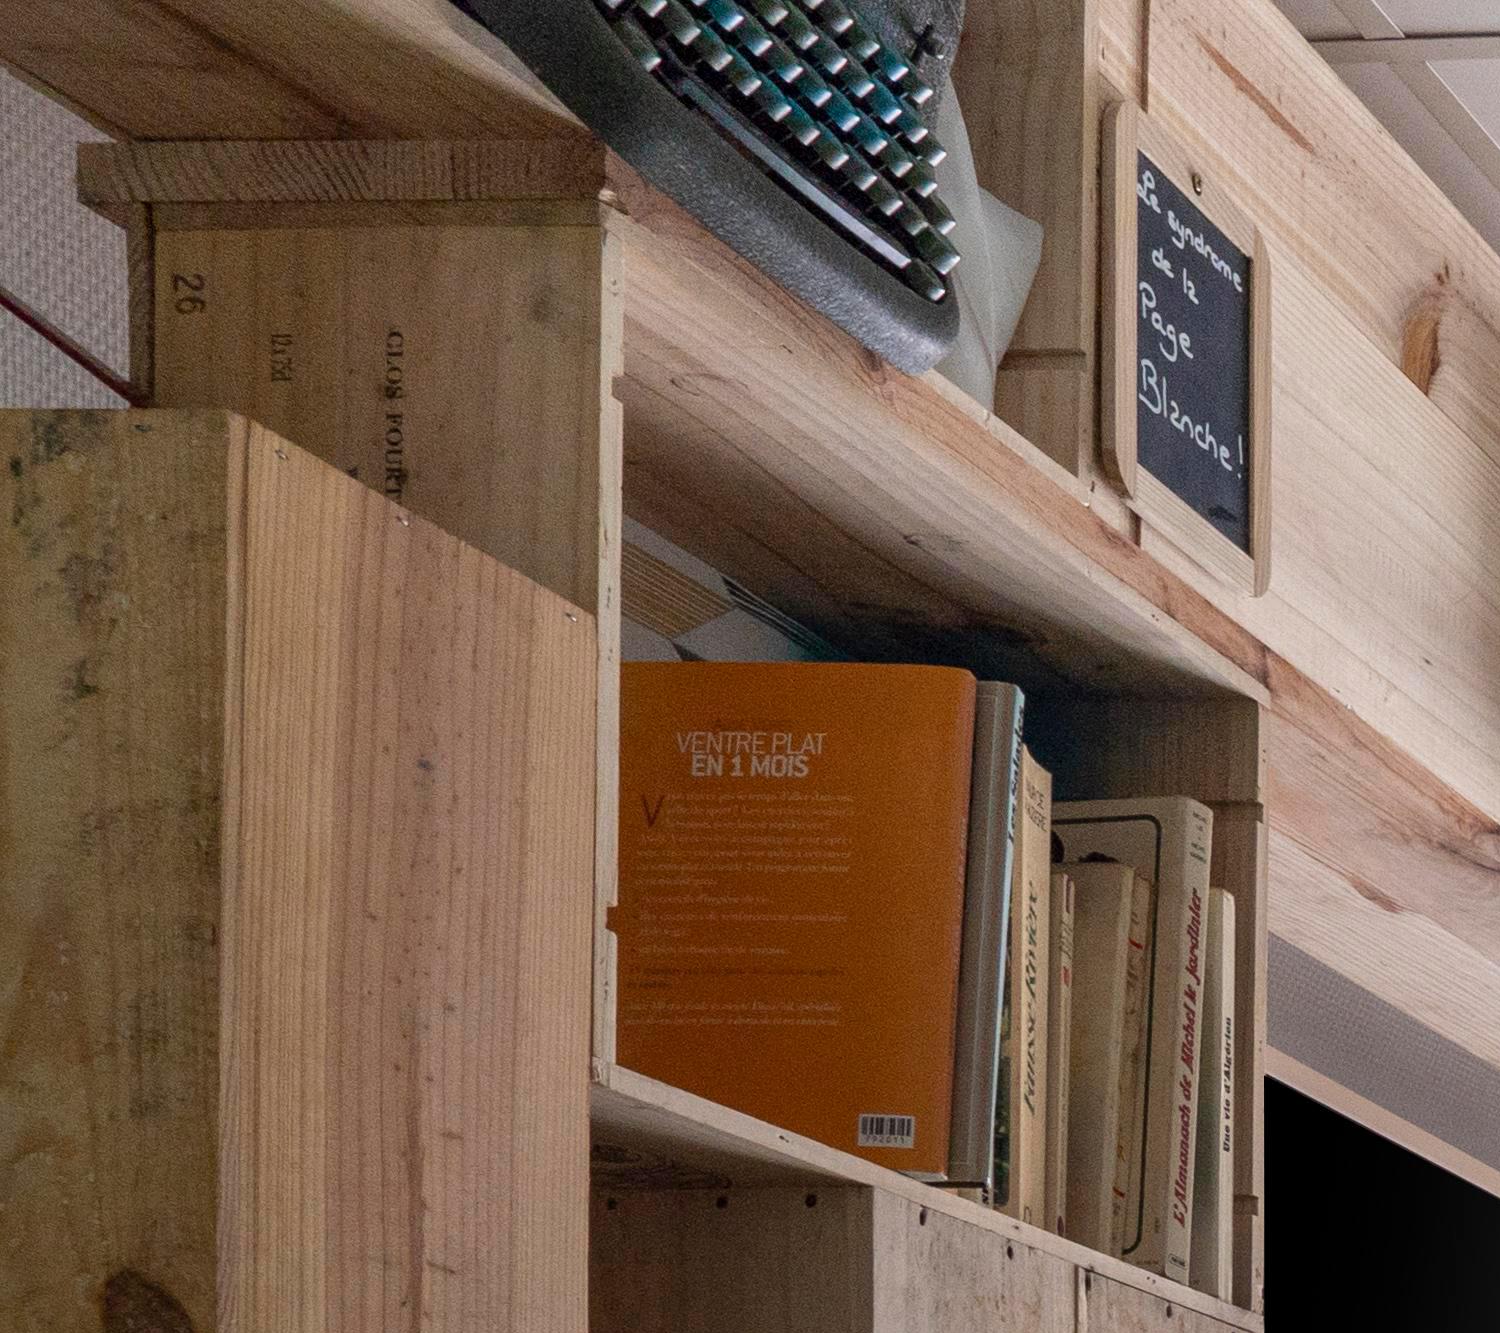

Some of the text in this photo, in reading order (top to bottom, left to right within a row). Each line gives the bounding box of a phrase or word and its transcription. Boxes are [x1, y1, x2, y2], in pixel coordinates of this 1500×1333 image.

[1137, 170, 1161, 214] Le
[173, 273, 206, 315] 26
[1151, 247, 1200, 305] de la
[1138, 281, 1194, 362] Page
[386, 331, 404, 400] CLOS
[677, 729, 827, 756] VENTRE PLAT
[690, 755, 809, 779] EN 1 MOIS
[1180, 1007, 1198, 1074] Michel
[1178, 1077, 1193, 1101] de
[1222, 1099, 1233, 1122] vie
[1222, 1127, 1232, 1152] Une
[1171, 1104, 1193, 1227] L'Almanach
